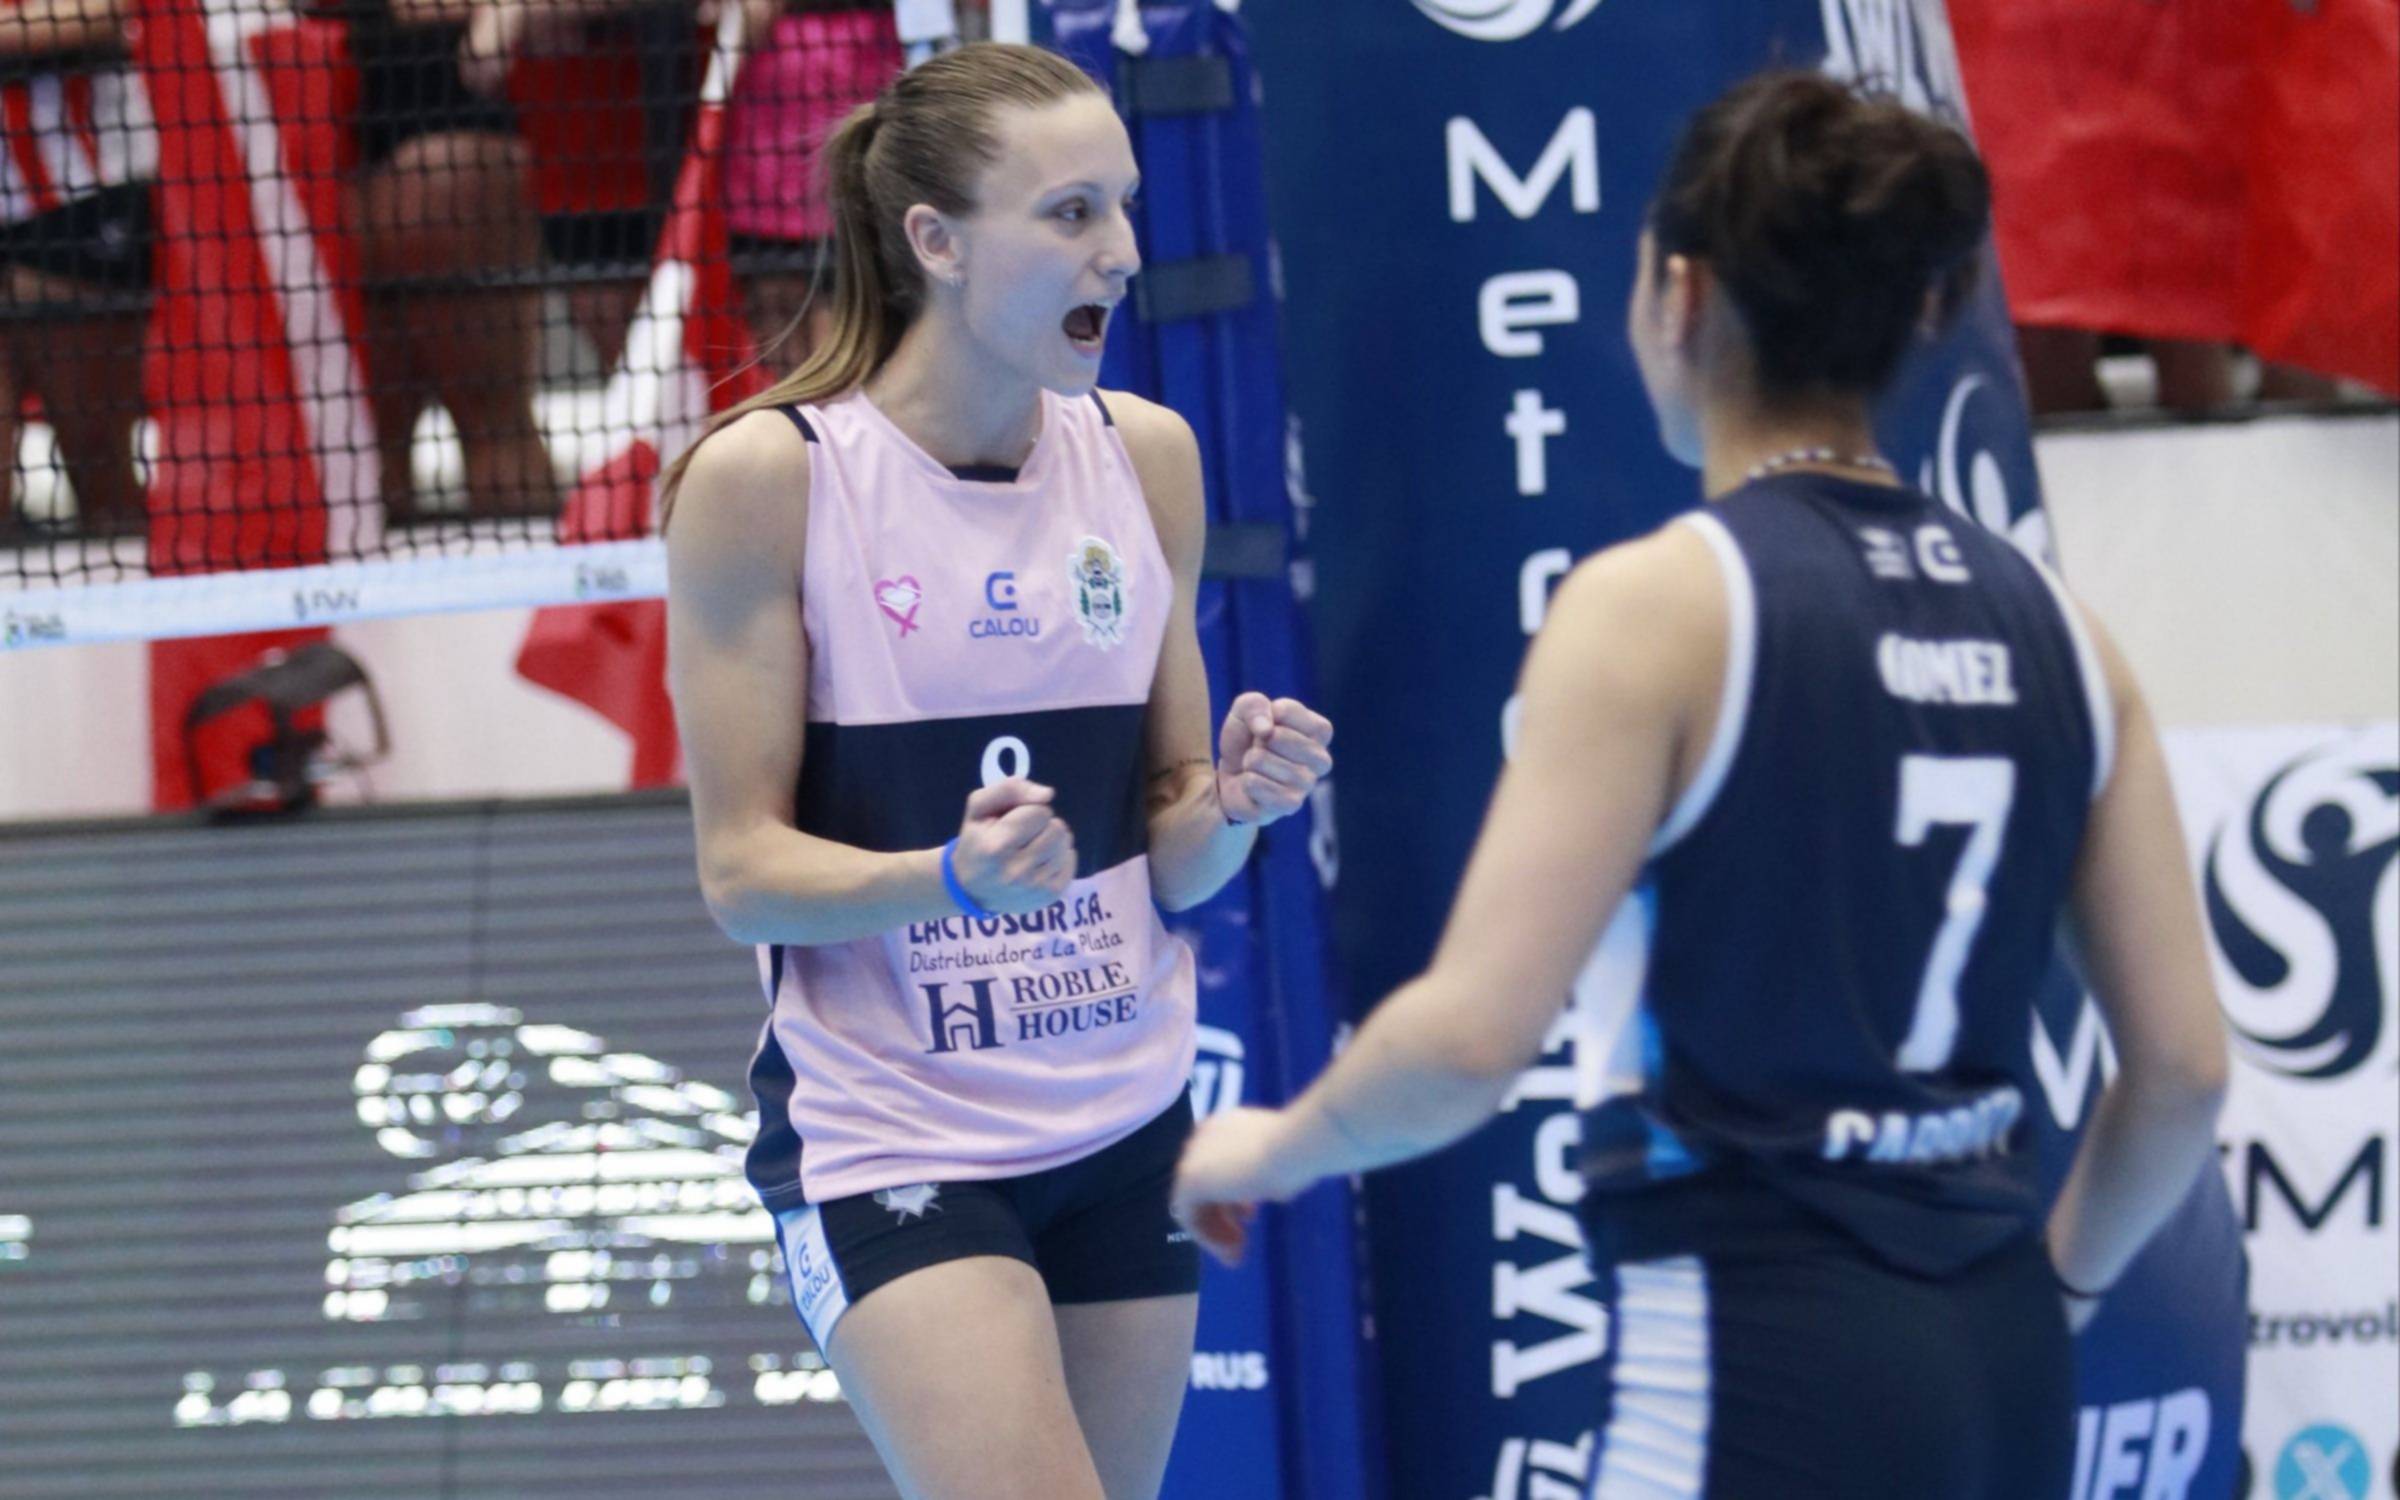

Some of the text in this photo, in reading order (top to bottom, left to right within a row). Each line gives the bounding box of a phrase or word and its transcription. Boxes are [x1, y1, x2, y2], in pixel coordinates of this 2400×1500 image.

[969, 617, 1040, 639] CALOU
[1896, 756, 2016, 1072] 7
[910, 930, 1123, 973] Distribuidora La Plata
[1010, 961, 1130, 1004] ROBLE
[1016, 993, 1138, 1041] HOUSE
